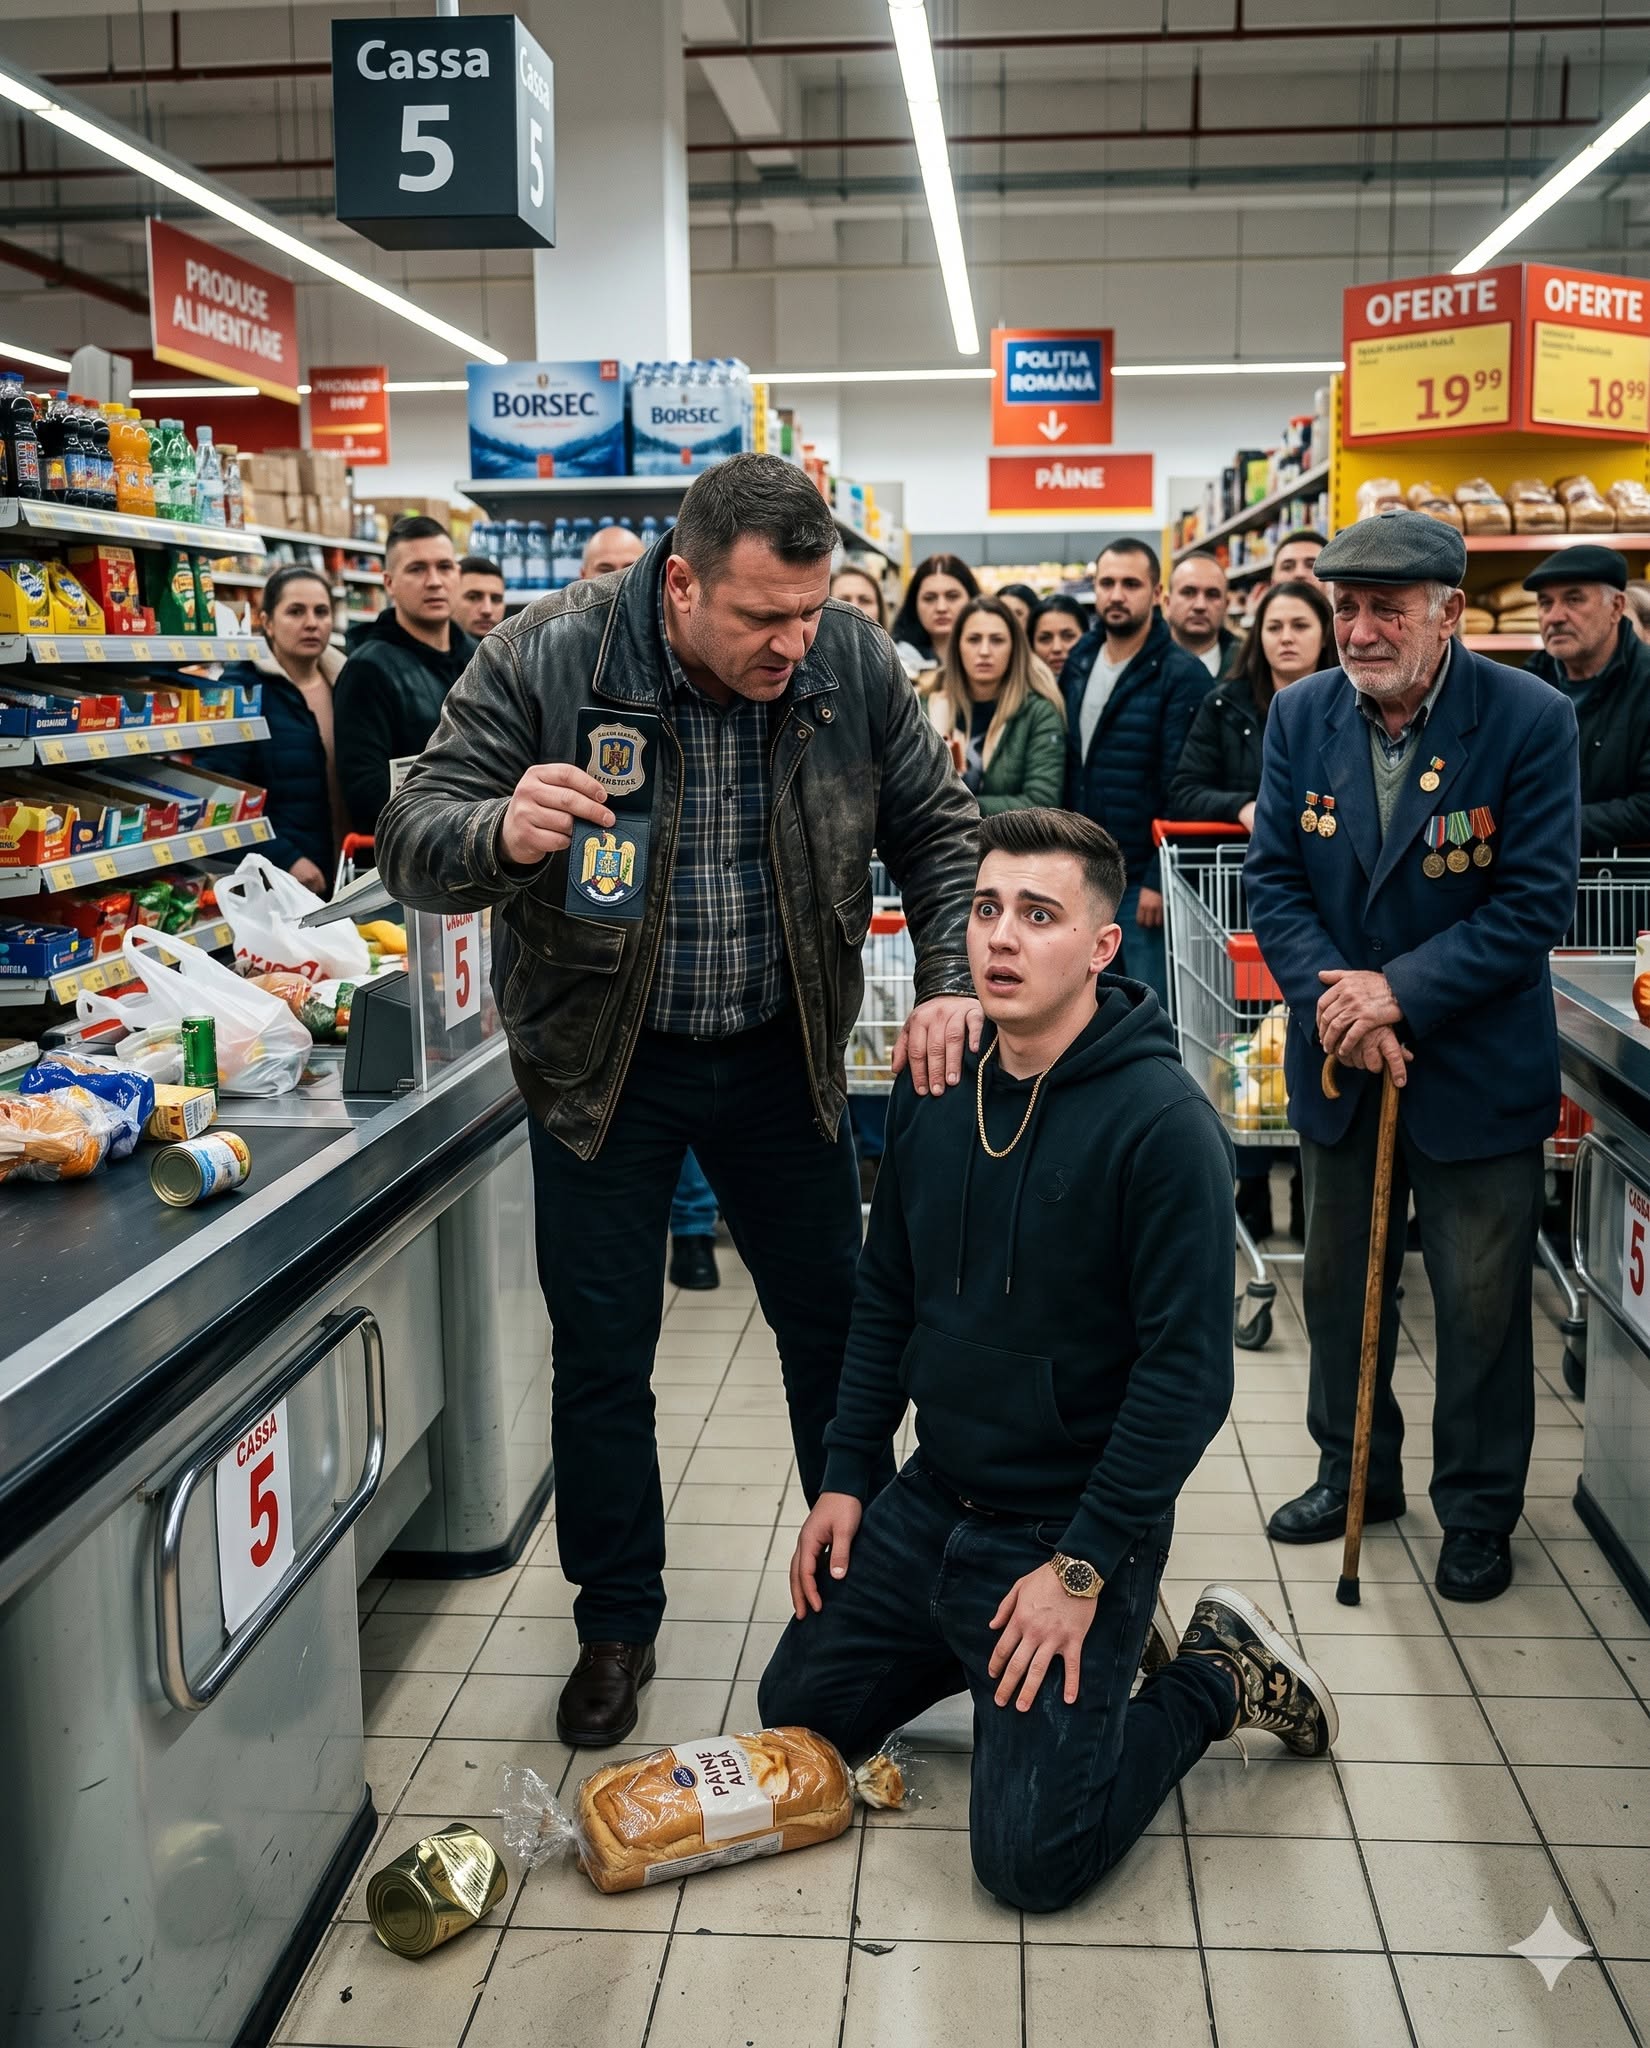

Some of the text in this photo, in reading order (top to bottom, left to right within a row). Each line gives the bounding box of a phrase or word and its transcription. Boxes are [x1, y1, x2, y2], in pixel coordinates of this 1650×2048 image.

[356, 40, 490, 80] Cassa
[519, 46, 550, 112] Cassa
[398, 104, 454, 193] 5
[530, 117, 545, 208] 5
[186, 258, 269, 321] PRODUSE
[1366, 278, 1498, 327] OFERTE
[1544, 277, 1644, 323] OFERTE
[173, 294, 283, 362] ALIMENTARE
[492, 391, 597, 418] BORSEC
[651, 406, 723, 424] BORSEC
[1416, 368, 1502, 422] 19 99
[1587, 377, 1646, 420] 18 99
[455, 936, 470, 1008] 5
[1630, 1219, 1645, 1296] 5
[237, 1413, 277, 1467] CASSA
[250, 1451, 279, 1568] 5
[696, 1751, 729, 1796] PÂINE
